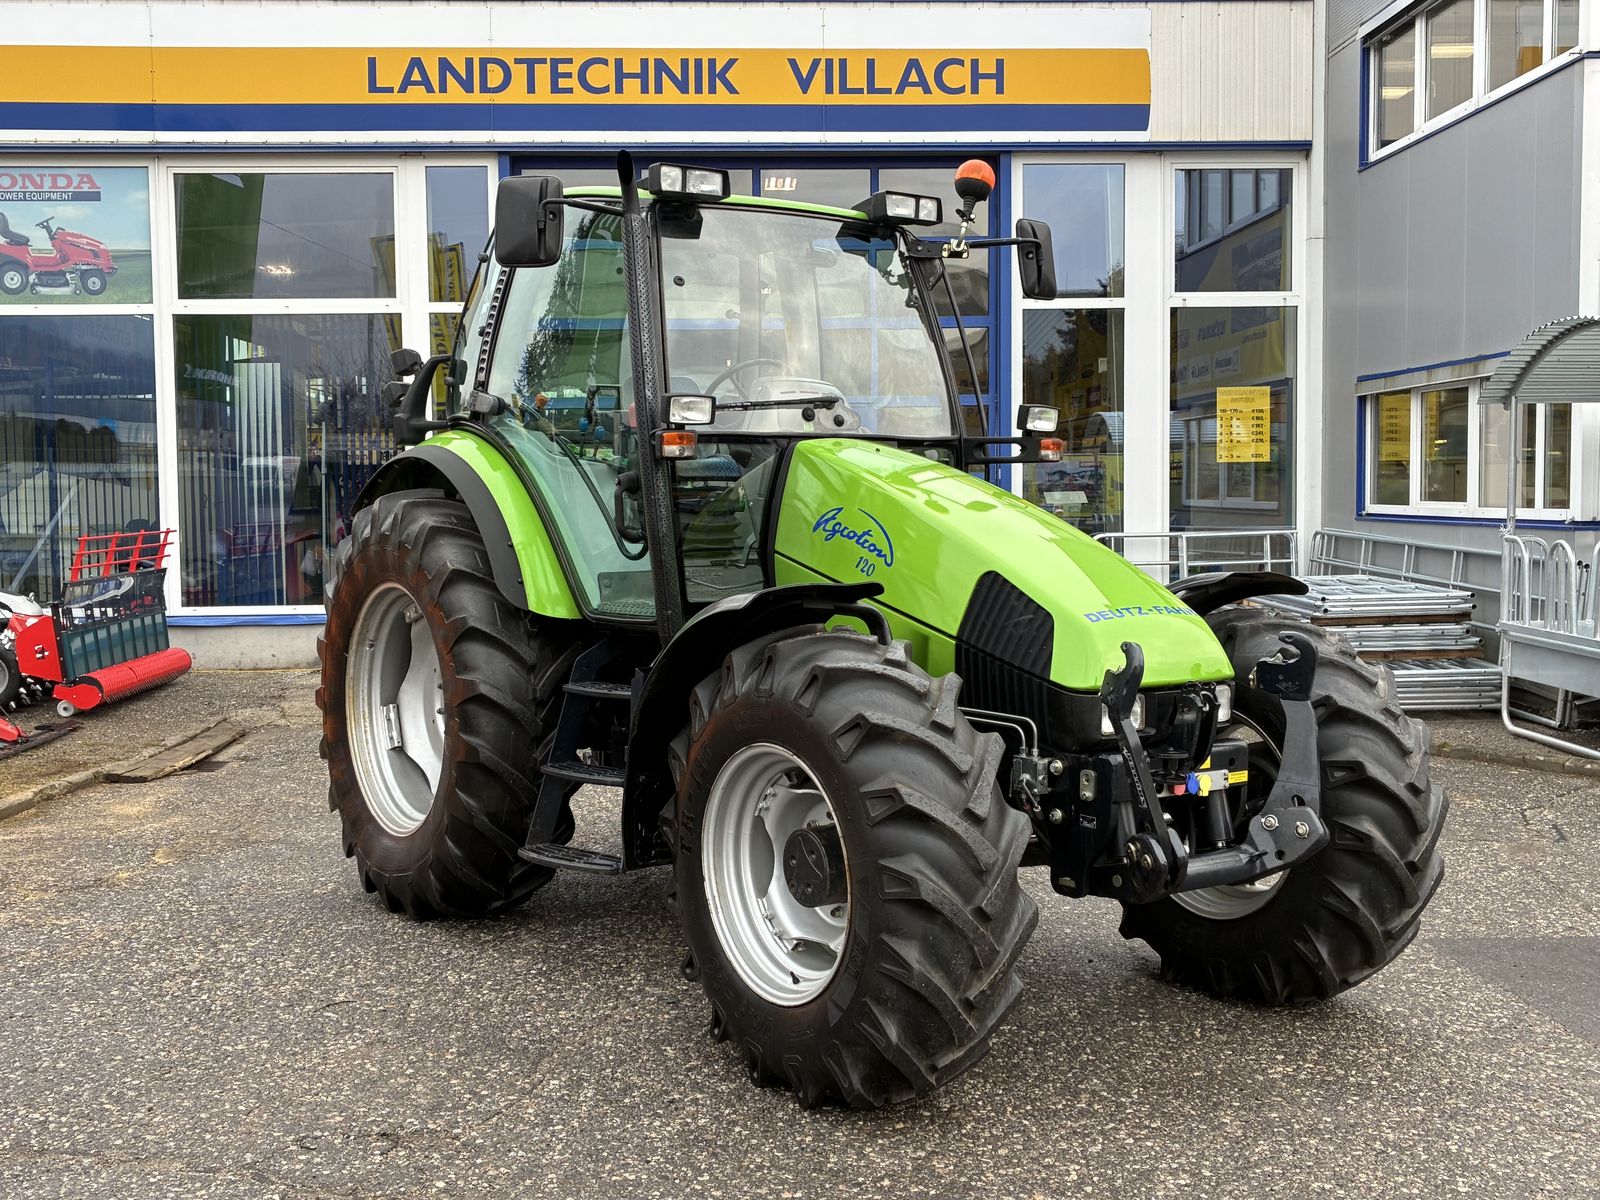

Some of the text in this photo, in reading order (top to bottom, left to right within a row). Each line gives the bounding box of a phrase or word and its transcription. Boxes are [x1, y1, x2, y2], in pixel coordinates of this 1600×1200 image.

[367, 56, 1005, 95] LANDTECHNIK VILLACH
[0, 172, 101, 190] ONDA
[0, 192, 73, 201] OWER EQUIPMENT
[812, 507, 895, 568] Agroton
[855, 556, 876, 577] 120
